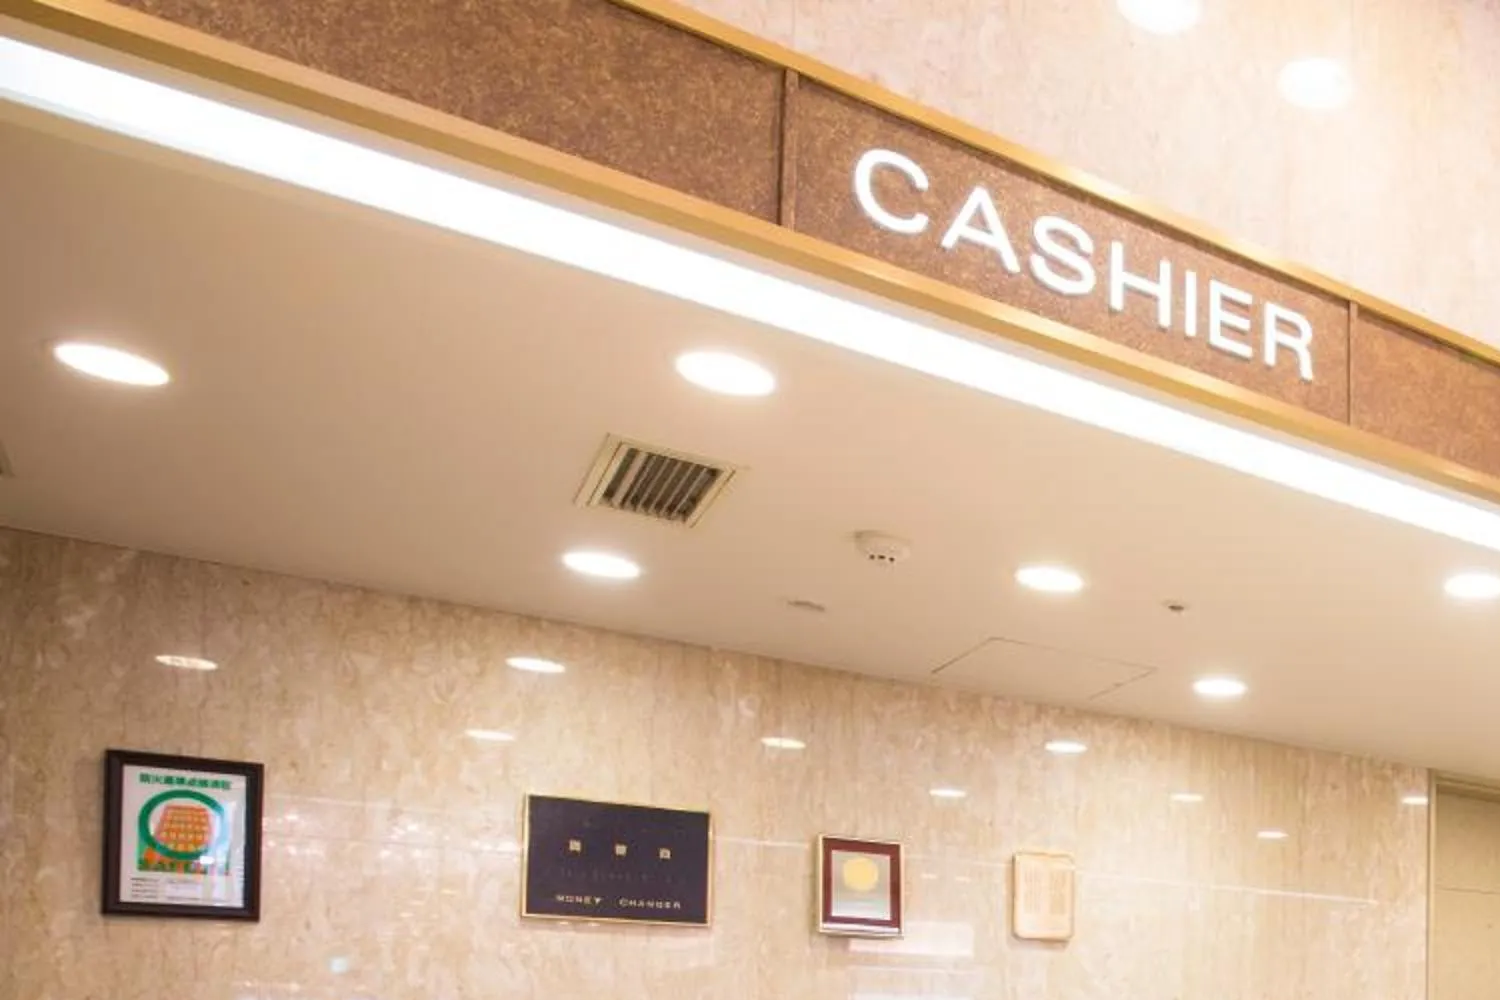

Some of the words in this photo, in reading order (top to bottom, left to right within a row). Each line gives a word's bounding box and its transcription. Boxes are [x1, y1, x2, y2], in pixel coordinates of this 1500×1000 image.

[853, 148, 1314, 382] CASHIER
[556, 894, 602, 905] MONEY
[619, 897, 682, 910] CHANGER
